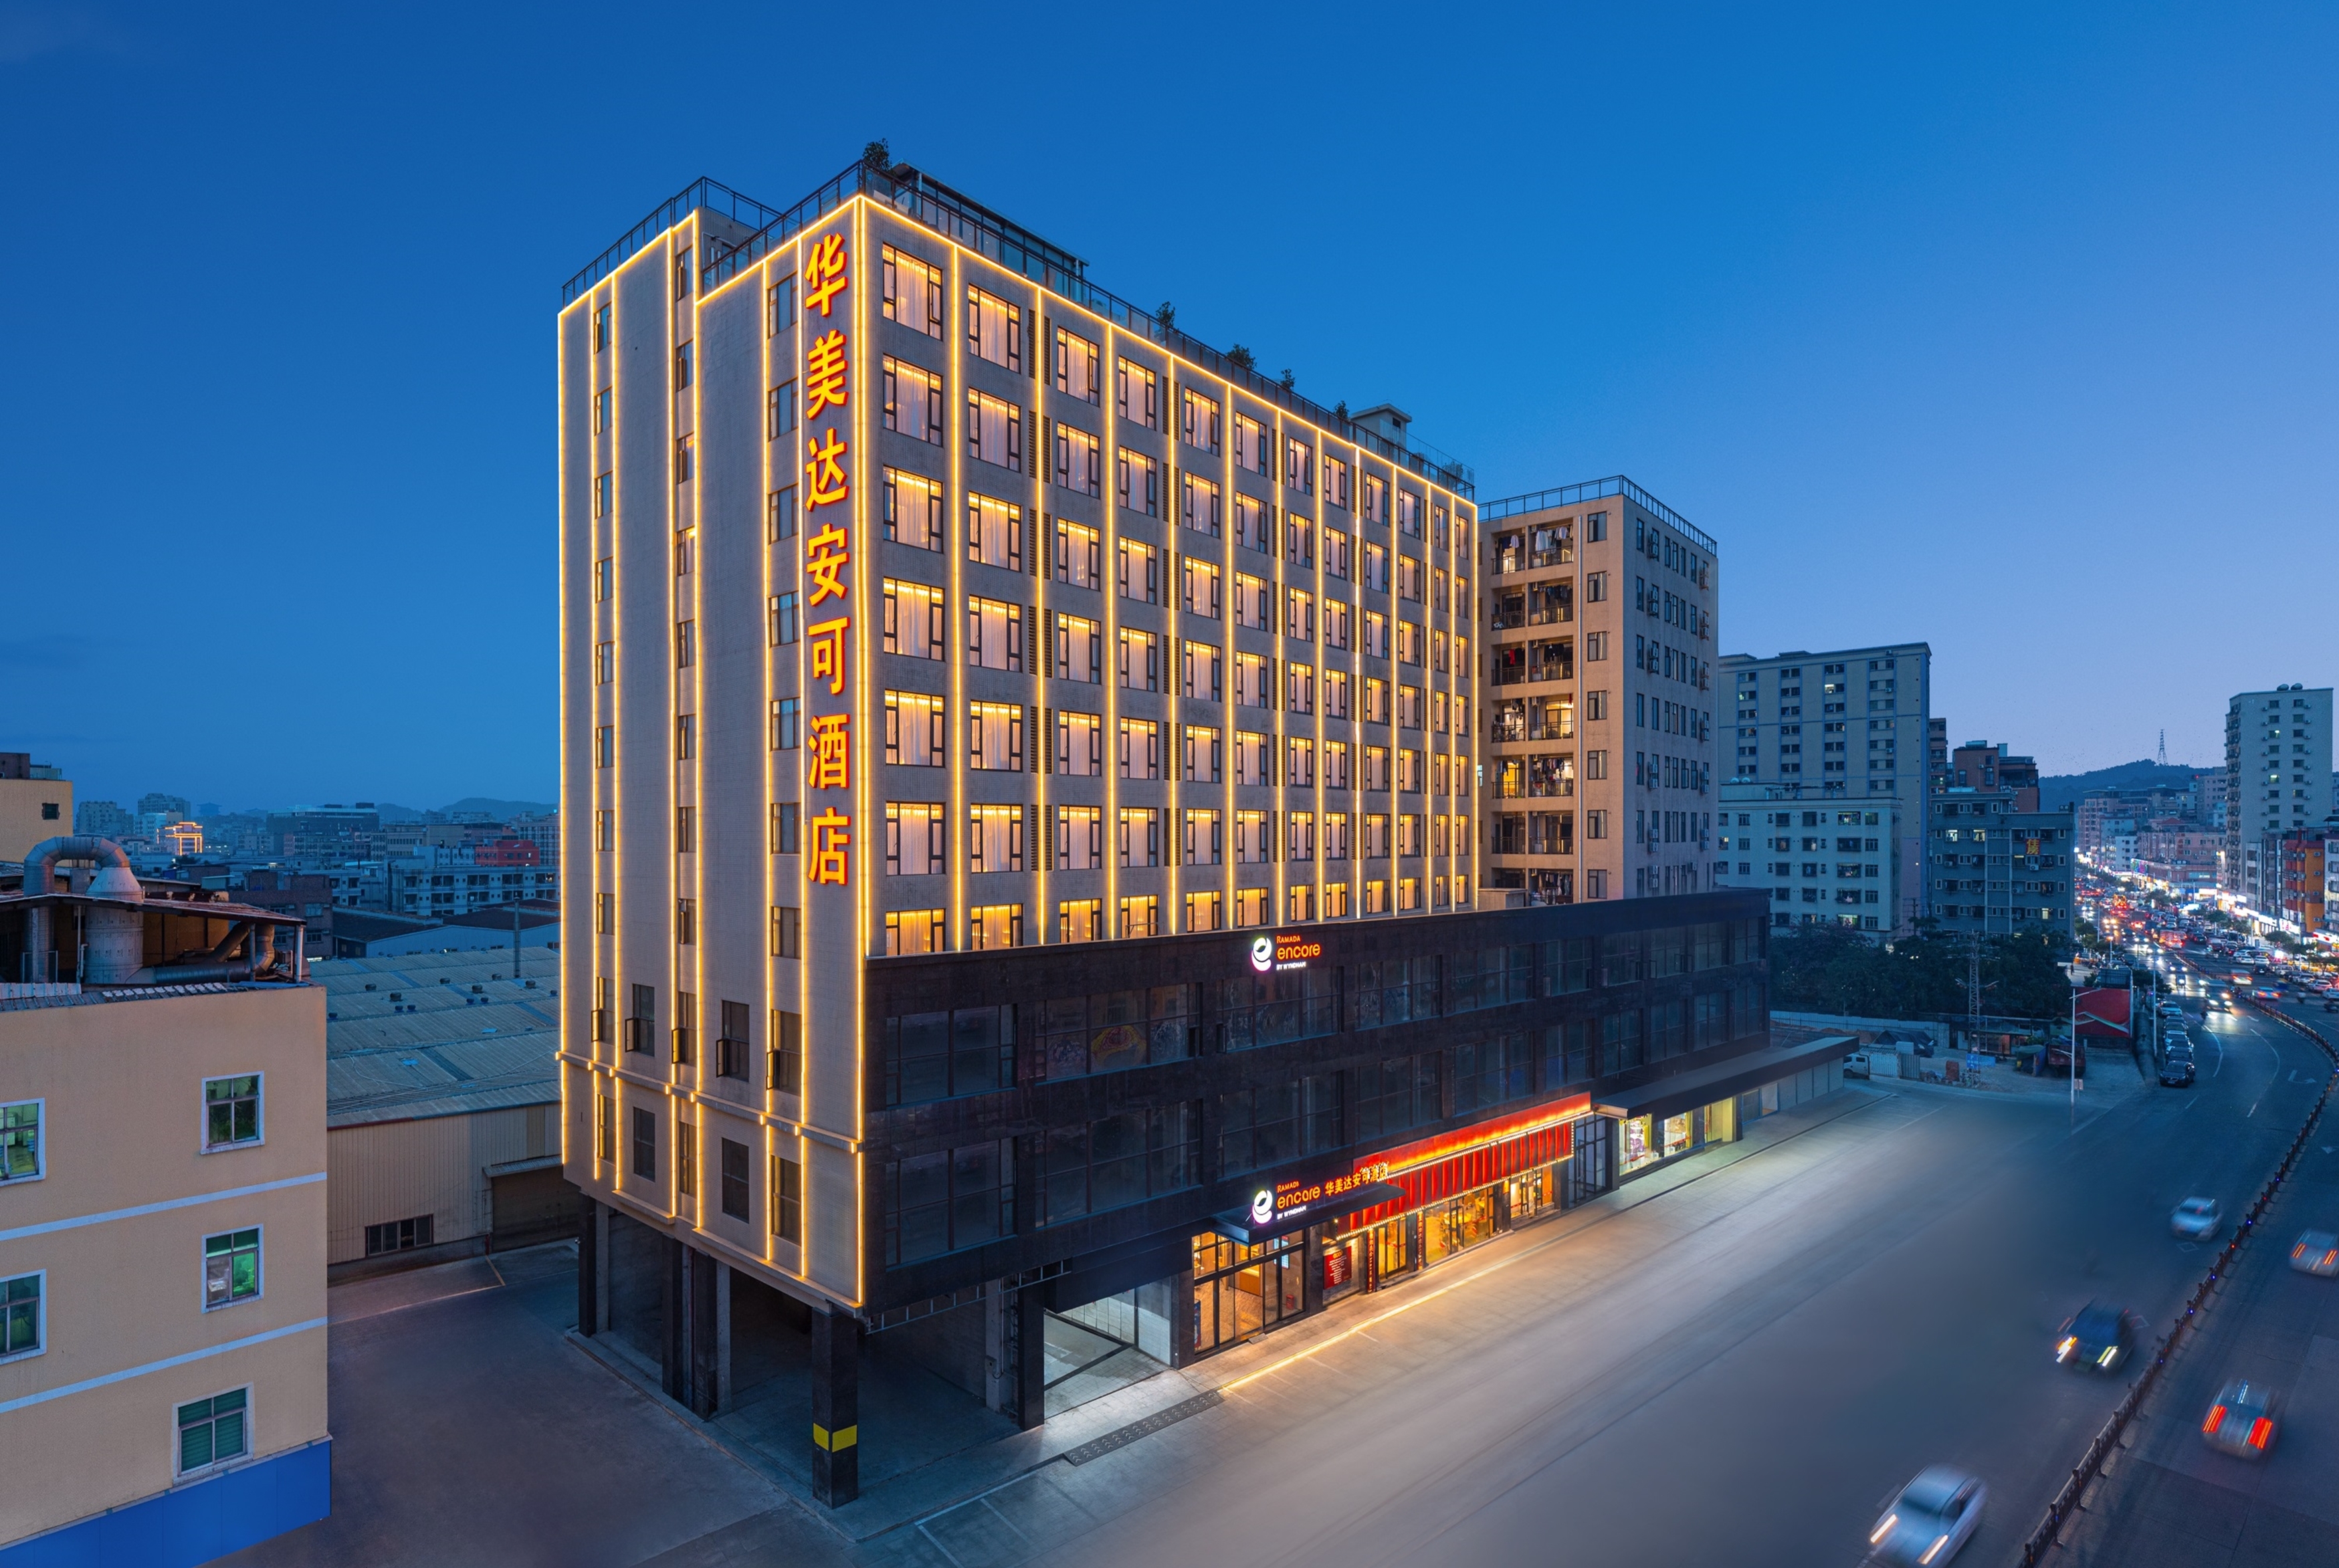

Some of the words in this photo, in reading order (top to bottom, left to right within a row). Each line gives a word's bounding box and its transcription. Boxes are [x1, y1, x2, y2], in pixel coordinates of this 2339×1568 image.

[803, 232, 851, 887] 华美达安可酒店
[1276, 935, 1301, 943] RAMADA
[1277, 943, 1321, 960] encore
[1324, 1161, 1389, 1196] 华美达安可酒店
[1277, 1186, 1321, 1209] encore
